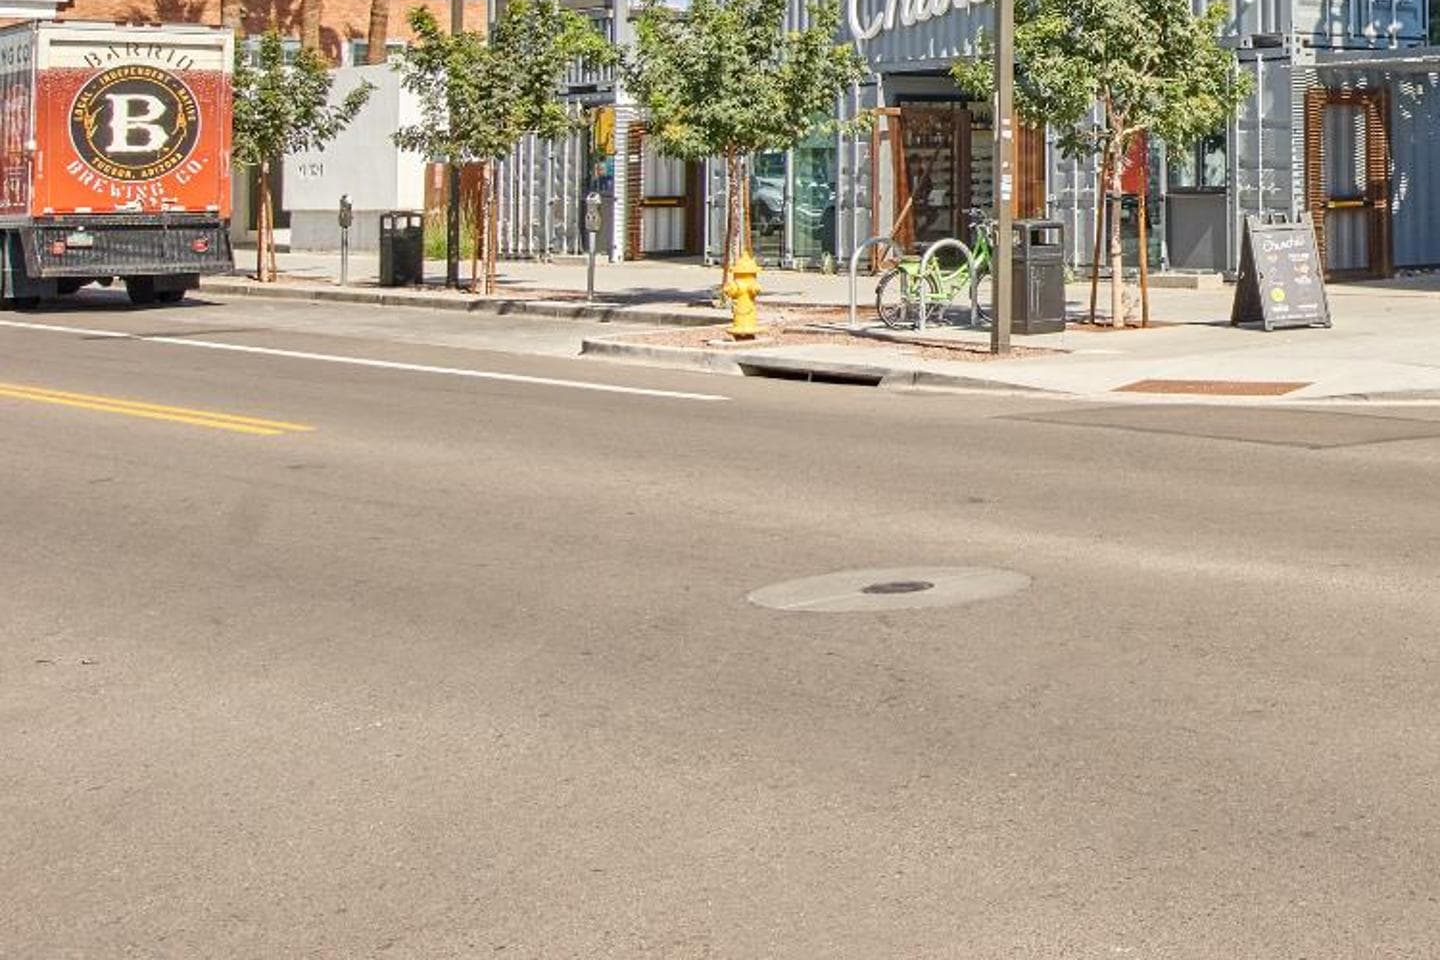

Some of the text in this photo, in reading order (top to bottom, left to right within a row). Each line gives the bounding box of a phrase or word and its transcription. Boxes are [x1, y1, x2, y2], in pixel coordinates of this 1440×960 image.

[84, 42, 194, 71] BARRIO
[100, 67, 170, 86] INDEPENDENT
[105, 93, 169, 152] B
[66, 160, 164, 198] BREWING
[141, 152, 184, 178] ARIZONA
